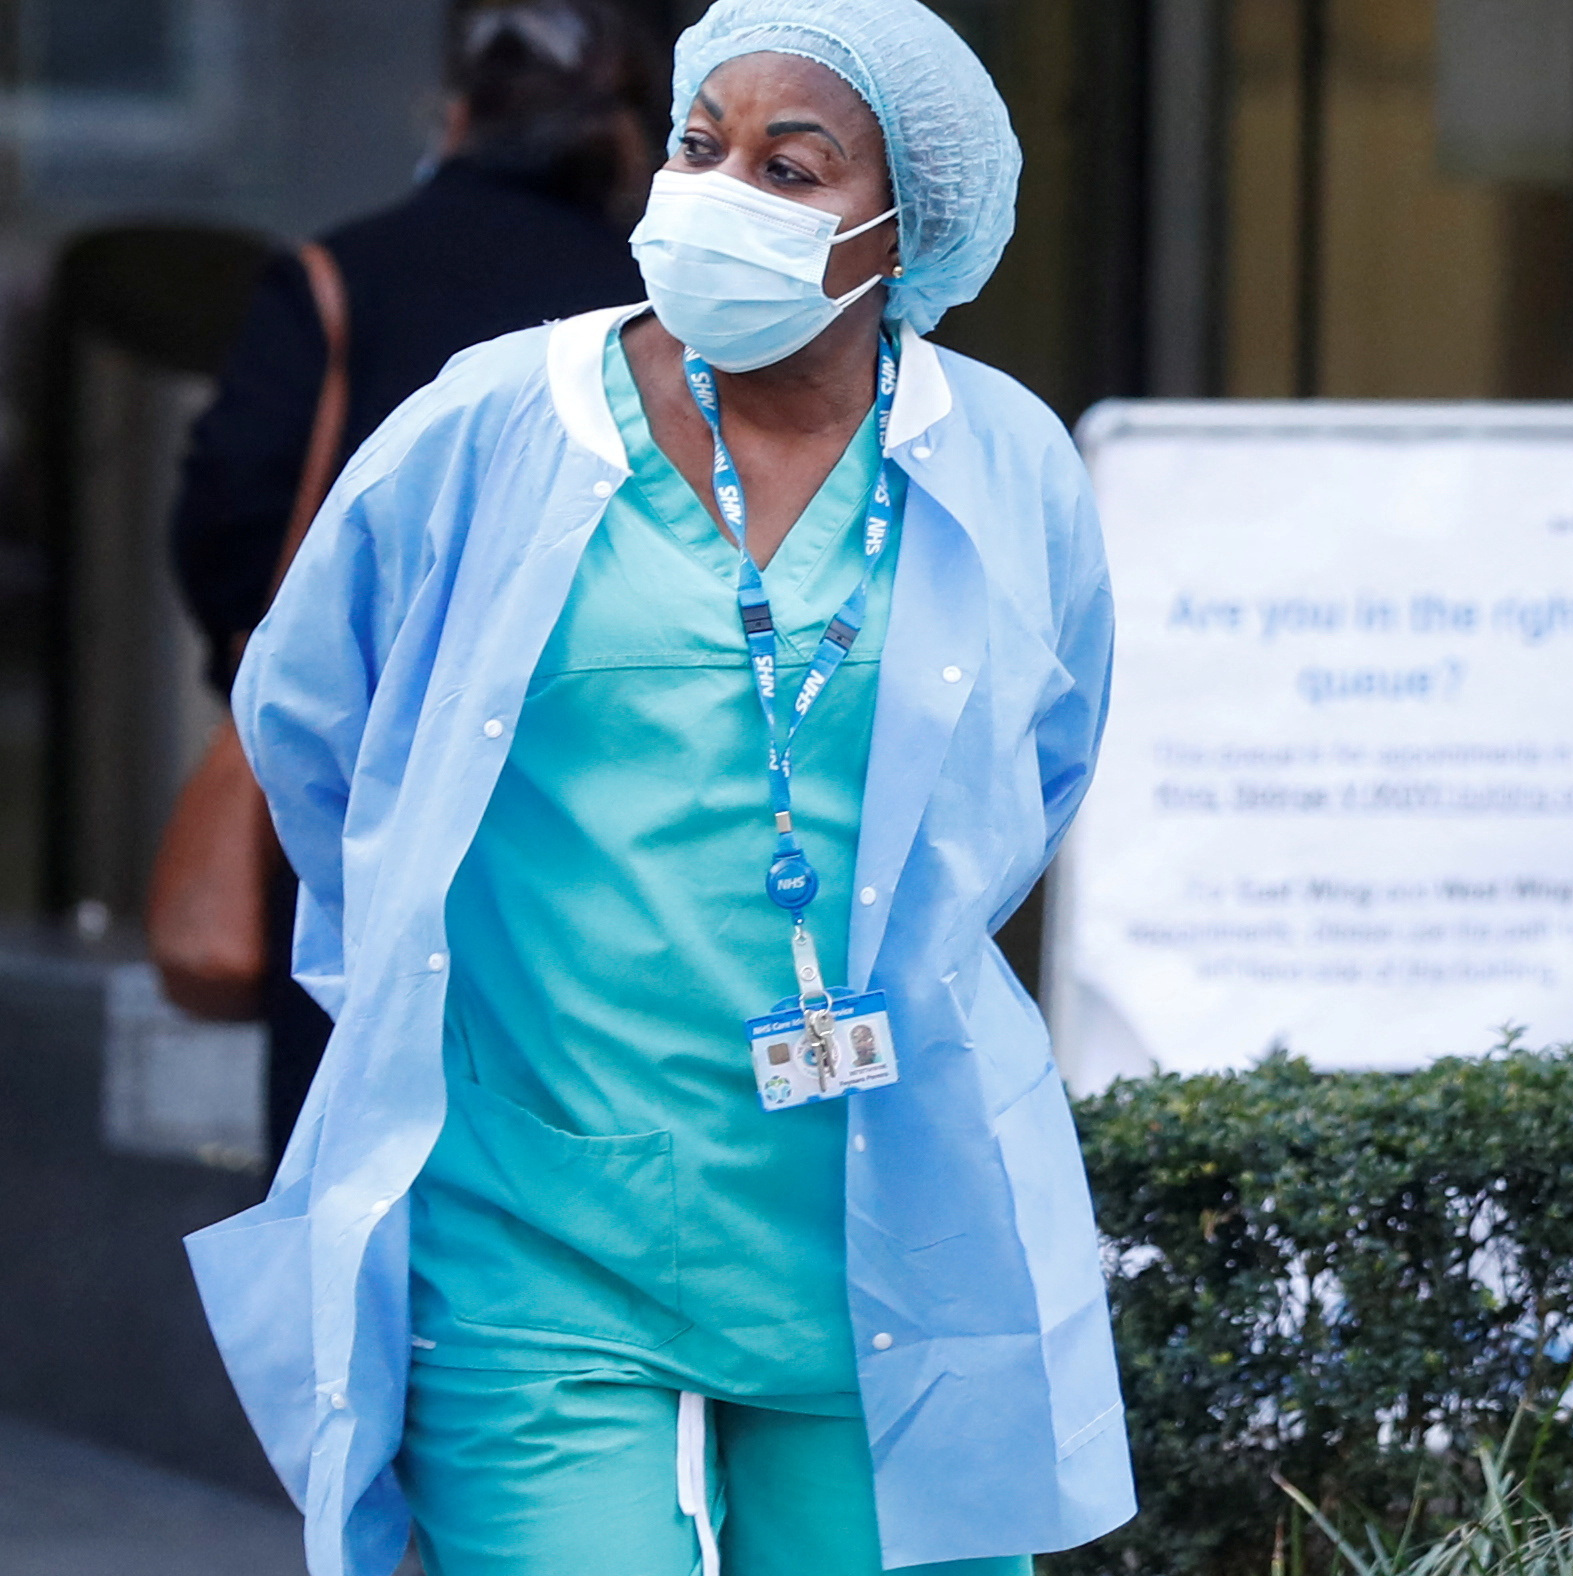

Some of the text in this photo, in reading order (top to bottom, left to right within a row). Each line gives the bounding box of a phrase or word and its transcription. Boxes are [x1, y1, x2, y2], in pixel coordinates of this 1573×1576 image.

[690, 371, 716, 411] NHS
[881, 354, 896, 396] NHS
[717, 484, 742, 525] NHS
[866, 516, 887, 556] NHS
[1168, 589, 1243, 633] Are
[1256, 597, 1344, 645] you
[1354, 588, 1396, 633] in
[1409, 592, 1478, 634] the
[755, 654, 775, 698] NHS
[795, 669, 825, 716] NHS
[1297, 657, 1468, 707] queue?
[777, 874, 806, 891] NHS
